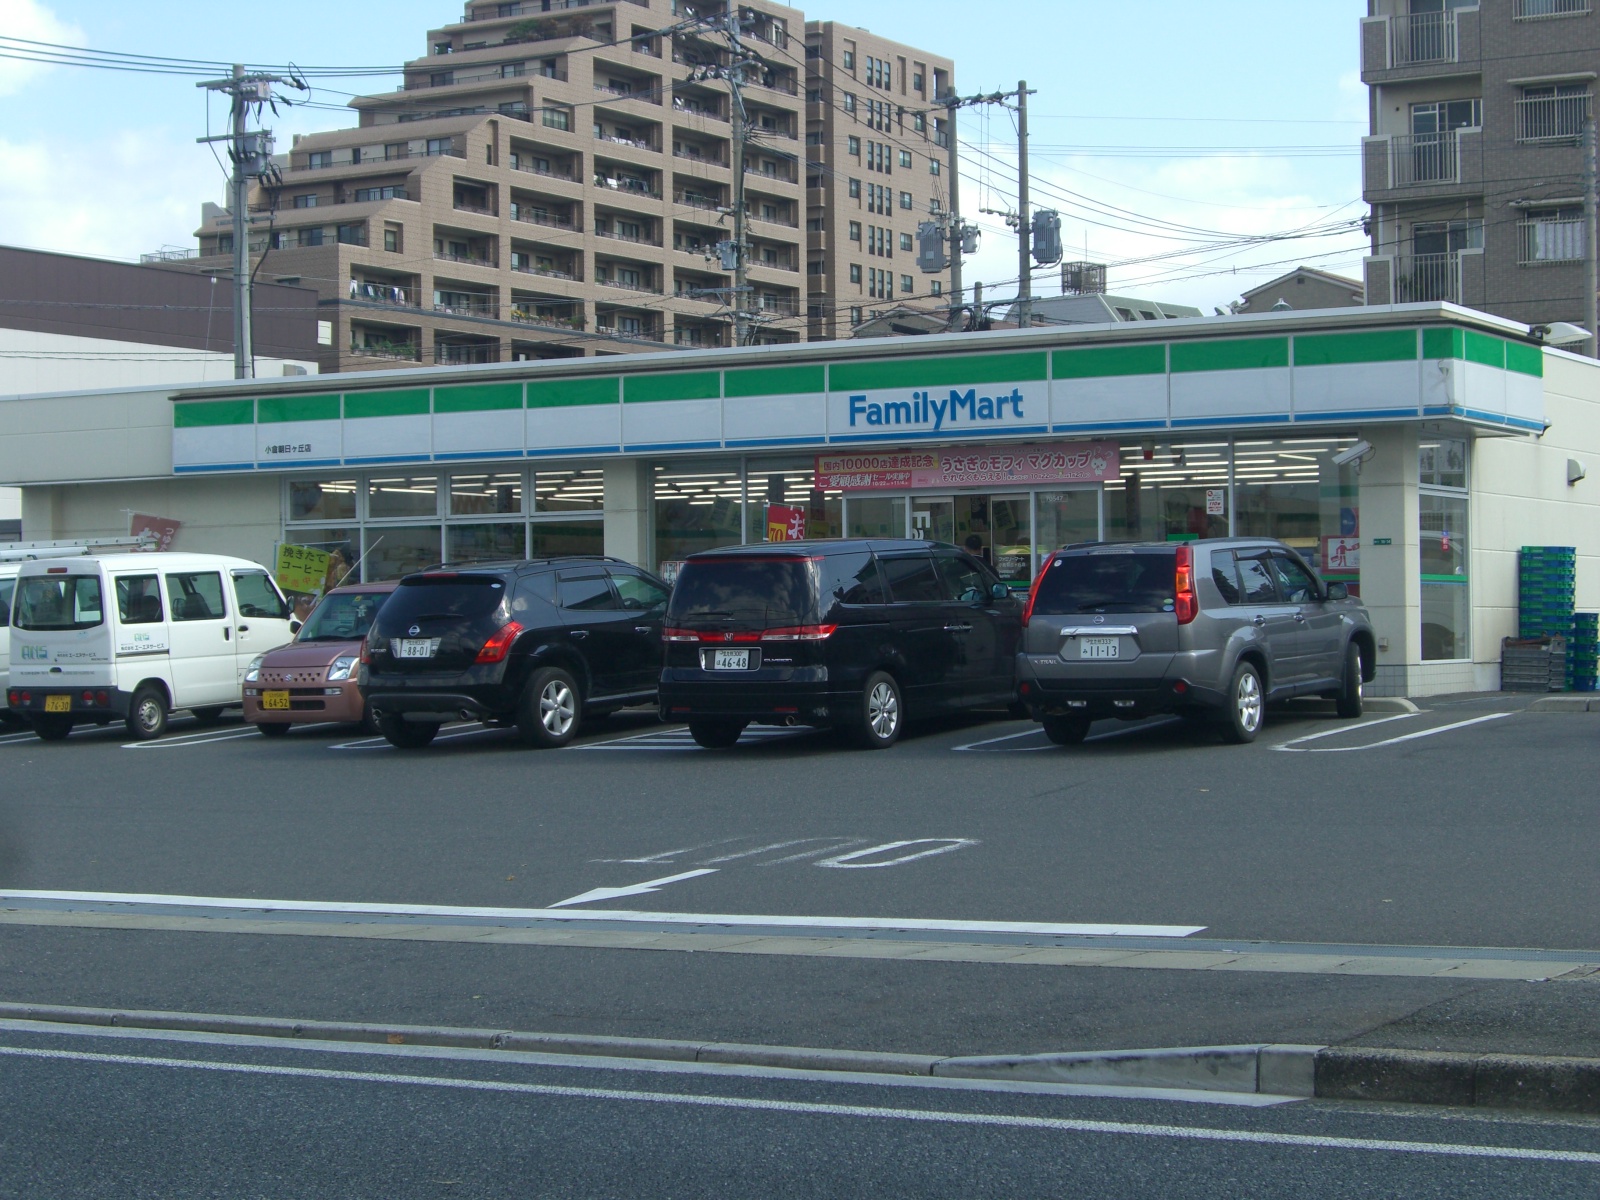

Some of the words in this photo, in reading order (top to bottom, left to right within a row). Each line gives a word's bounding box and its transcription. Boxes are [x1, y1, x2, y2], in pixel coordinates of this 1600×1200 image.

[849, 388, 1024, 431] FamilyMart
[823, 454, 934, 471] 国内10000店達成記念
[941, 454, 1024, 473] うさぎのモフィ
[1027, 451, 1092, 470] マグカップ
[283, 546, 326, 563] 挽きたて
[281, 561, 324, 574] コーヒー
[21, 645, 48, 660] ANS
[407, 646, 428, 656] 88-01
[1090, 645, 1117, 657] 11-13
[721, 657, 747, 668] 46-48
[269, 698, 288, 708] 64-52
